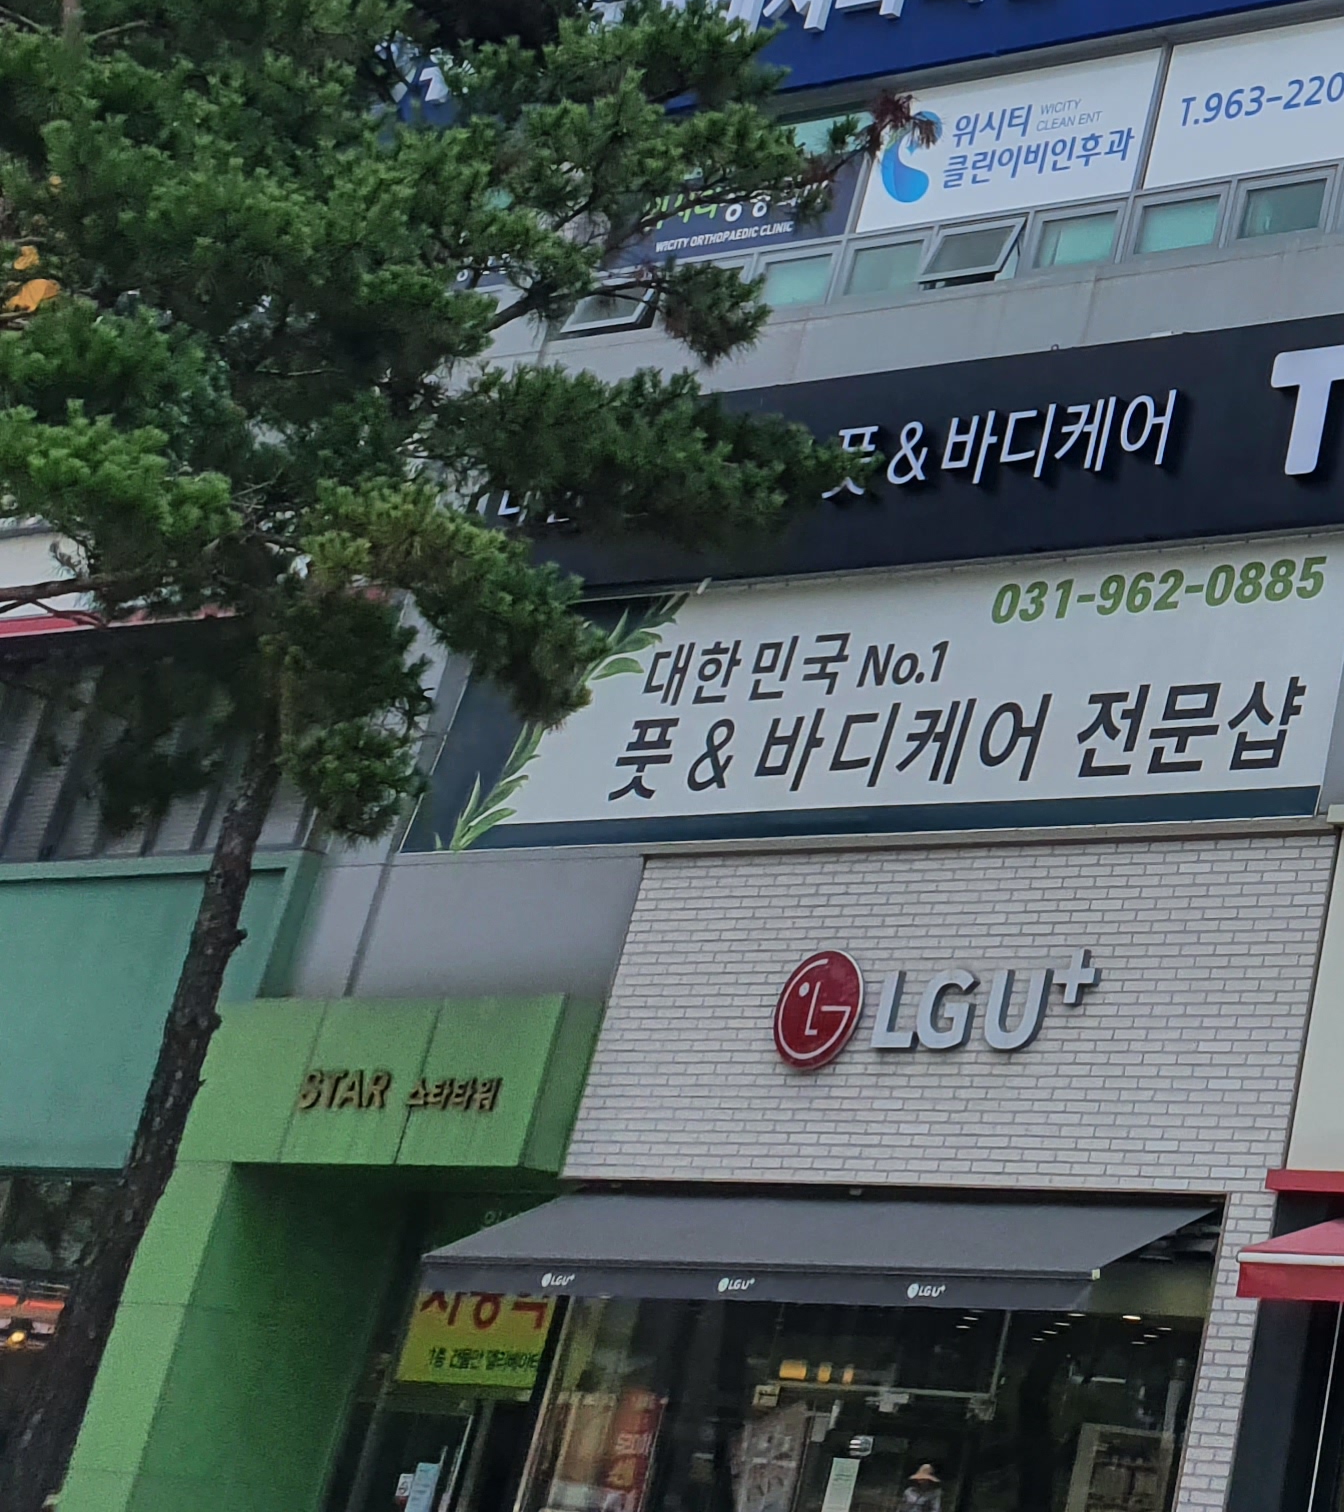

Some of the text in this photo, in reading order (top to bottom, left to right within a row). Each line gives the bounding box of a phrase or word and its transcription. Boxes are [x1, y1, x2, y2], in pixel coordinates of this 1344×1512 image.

[950, 101, 1034, 150] 위시티
[1036, 110, 1104, 133] CLEAN ENT
[1040, 98, 1082, 116] WICITY
[941, 125, 1137, 190] 클린이비인후과
[689, 225, 759, 248] ORTHOPAEDIC
[759, 219, 795, 237] CLINIC
[886, 419, 930, 487] &
[941, 388, 1179, 485] 바디케어
[990, 554, 1331, 627] 031-962-0885
[641, 629, 951, 709] 대한민국 No.1
[607, 674, 1308, 806] 풋 & 바디케어 전문샵
[299, 1068, 392, 1111] STAR
